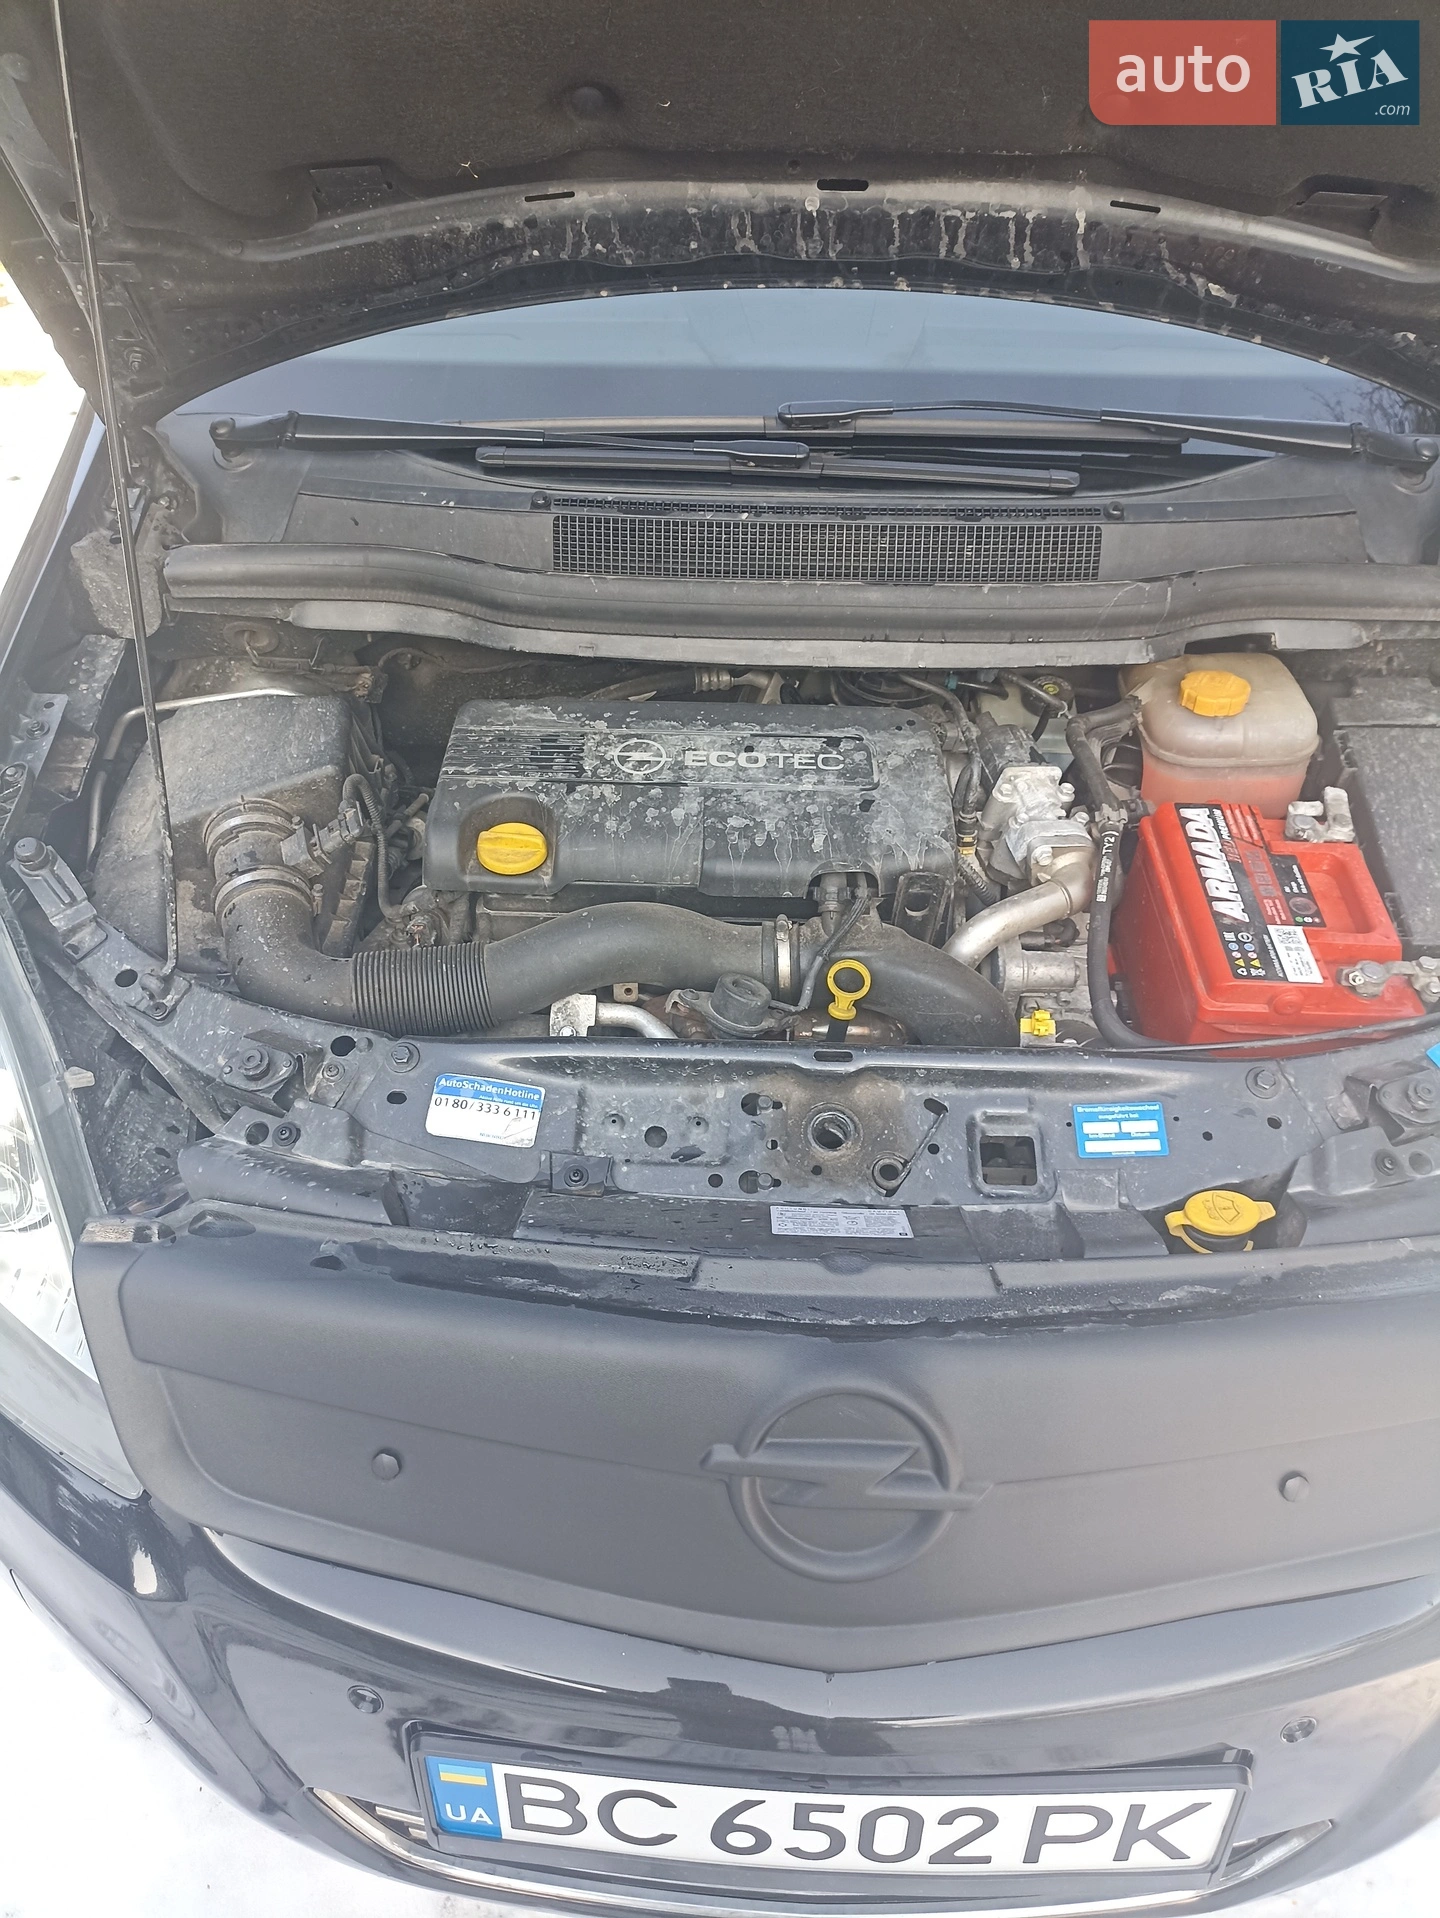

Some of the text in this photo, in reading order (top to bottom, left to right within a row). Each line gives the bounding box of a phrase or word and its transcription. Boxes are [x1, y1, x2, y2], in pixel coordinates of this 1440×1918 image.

[684, 750, 845, 770] ECOTEC
[1179, 808, 1250, 922] ARMADA
[438, 1078, 540, 1101] AutoSchadenHotline
[445, 1803, 494, 1825] UA
[504, 1772, 1213, 1865] BC 6502 PK
